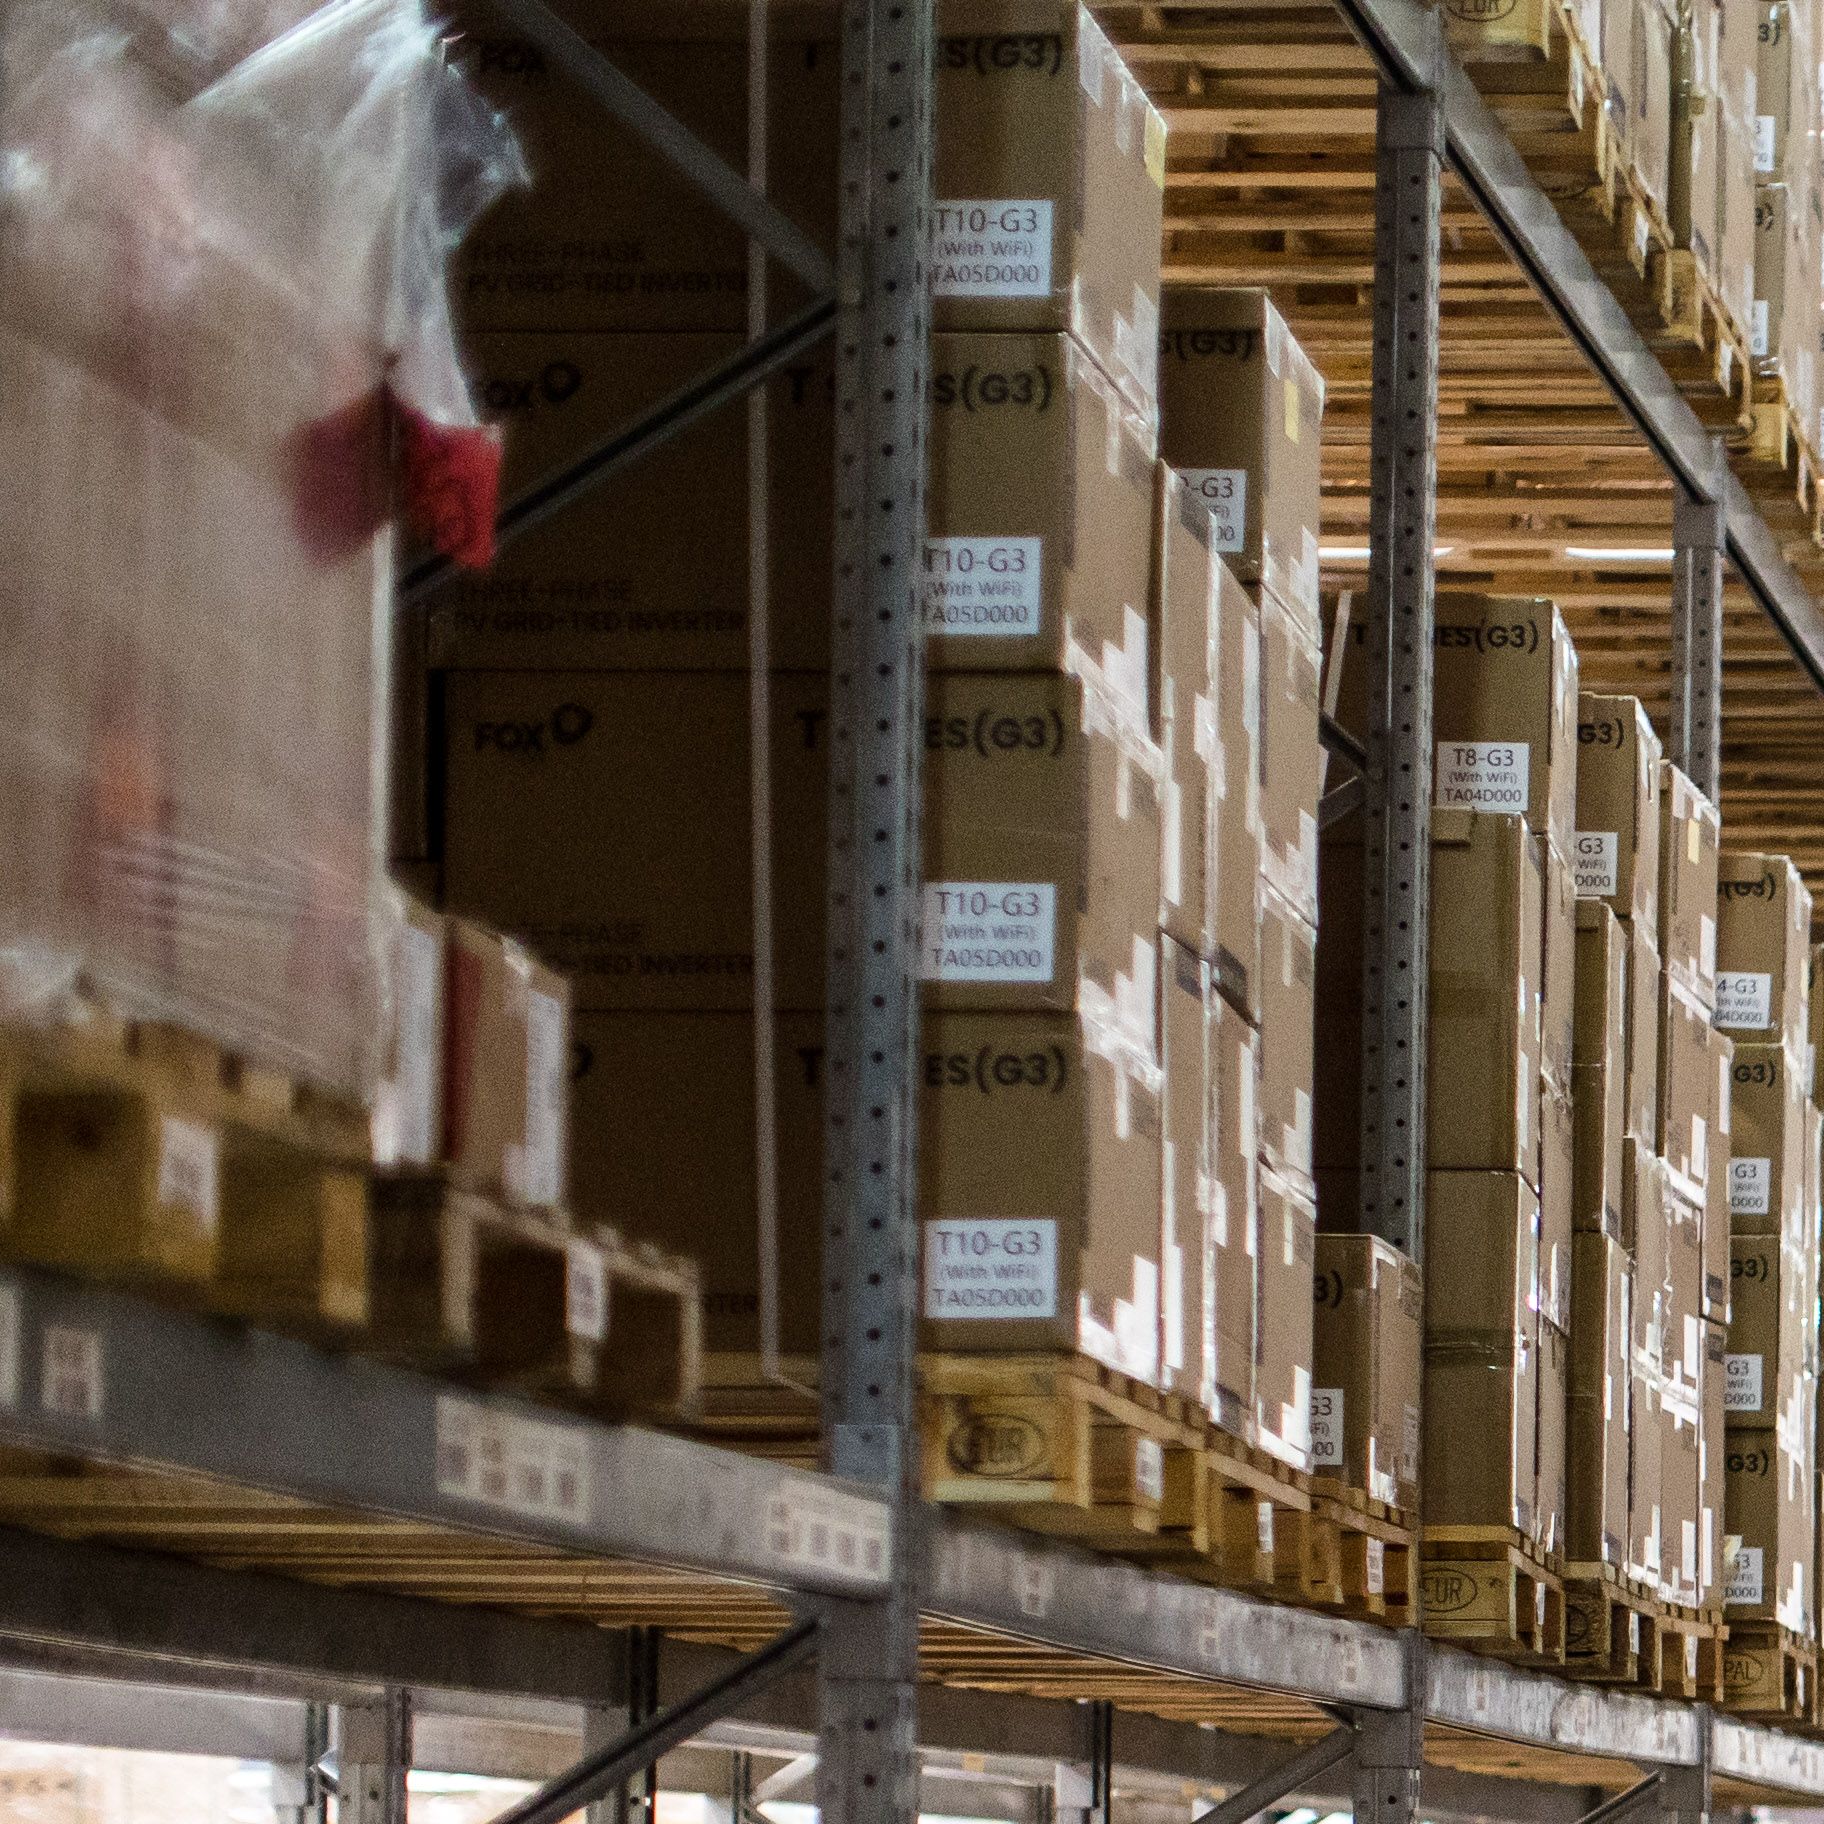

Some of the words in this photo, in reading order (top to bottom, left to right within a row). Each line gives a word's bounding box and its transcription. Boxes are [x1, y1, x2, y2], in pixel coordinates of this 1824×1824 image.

[933, 208, 1038, 234] T10-G3
[923, 547, 1026, 573] T10-G3
[1453, 748, 1514, 767] T8-G3
[1450, 772, 1483, 784] (With
[1487, 772, 1518, 784] WiFi)
[1444, 789, 1522, 802] TA04D000
[935, 891, 1040, 917] T10-G3
[936, 1230, 1042, 1256] T10-G3
